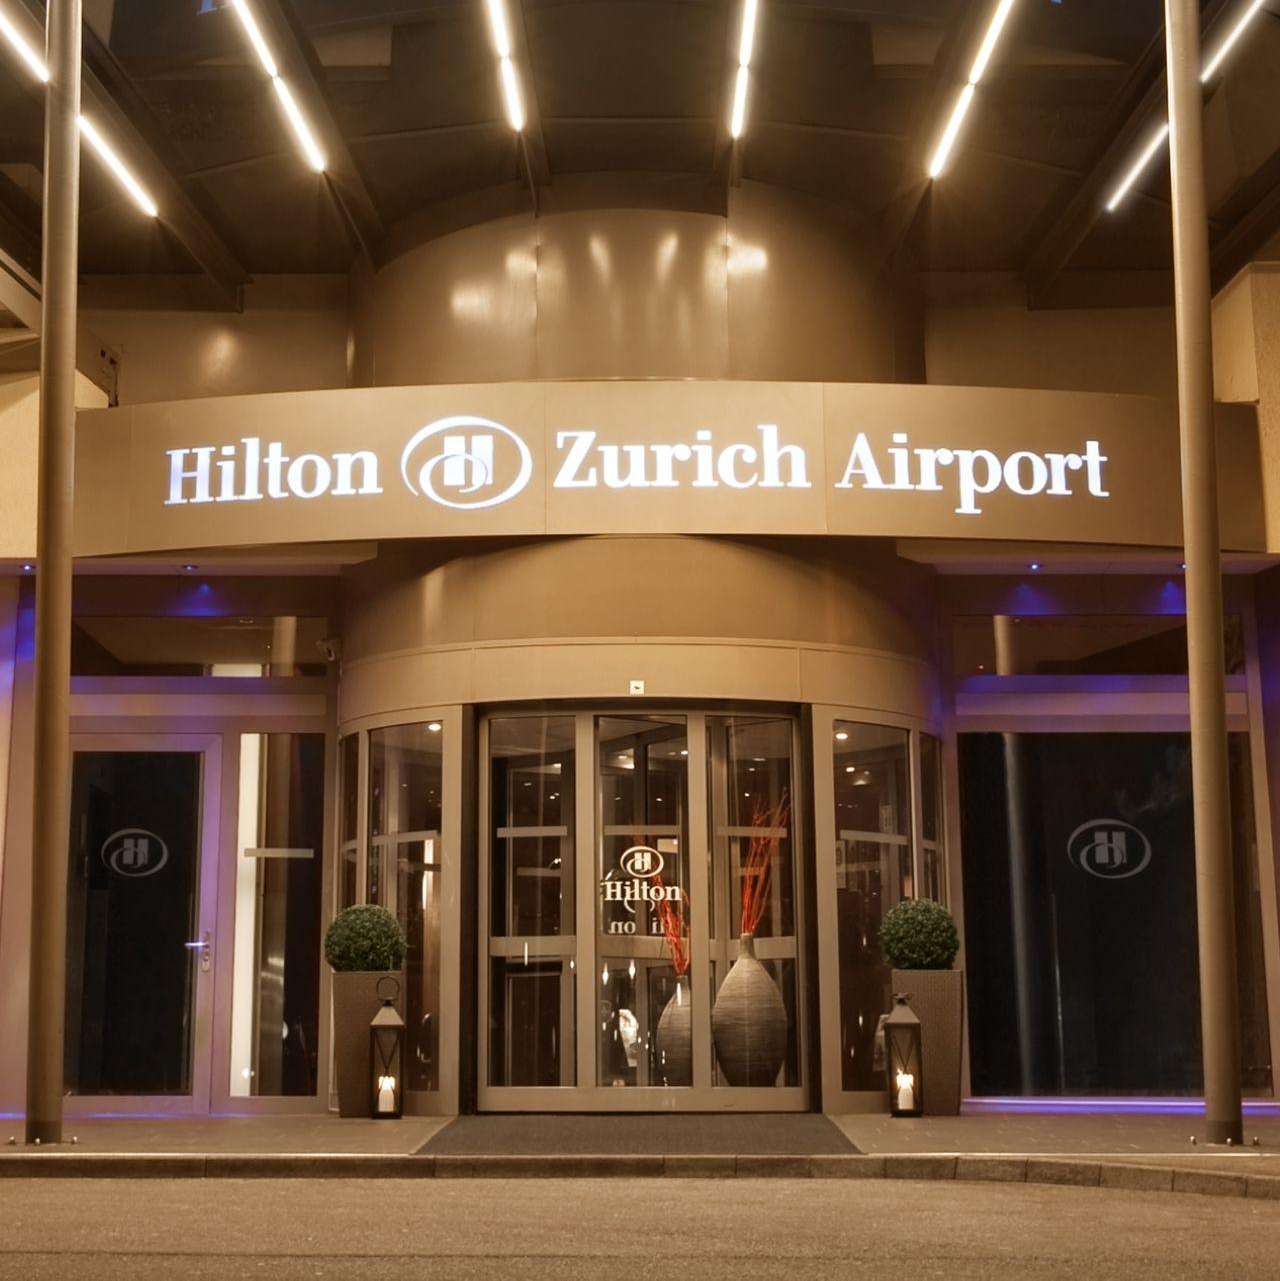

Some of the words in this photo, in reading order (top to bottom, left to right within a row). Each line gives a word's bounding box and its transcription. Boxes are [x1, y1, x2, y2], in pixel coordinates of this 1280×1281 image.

[163, 436, 384, 505] Hilton
[552, 423, 813, 489] Zurich
[833, 432, 1110, 515] Airport
[603, 879, 682, 901] Hilton
